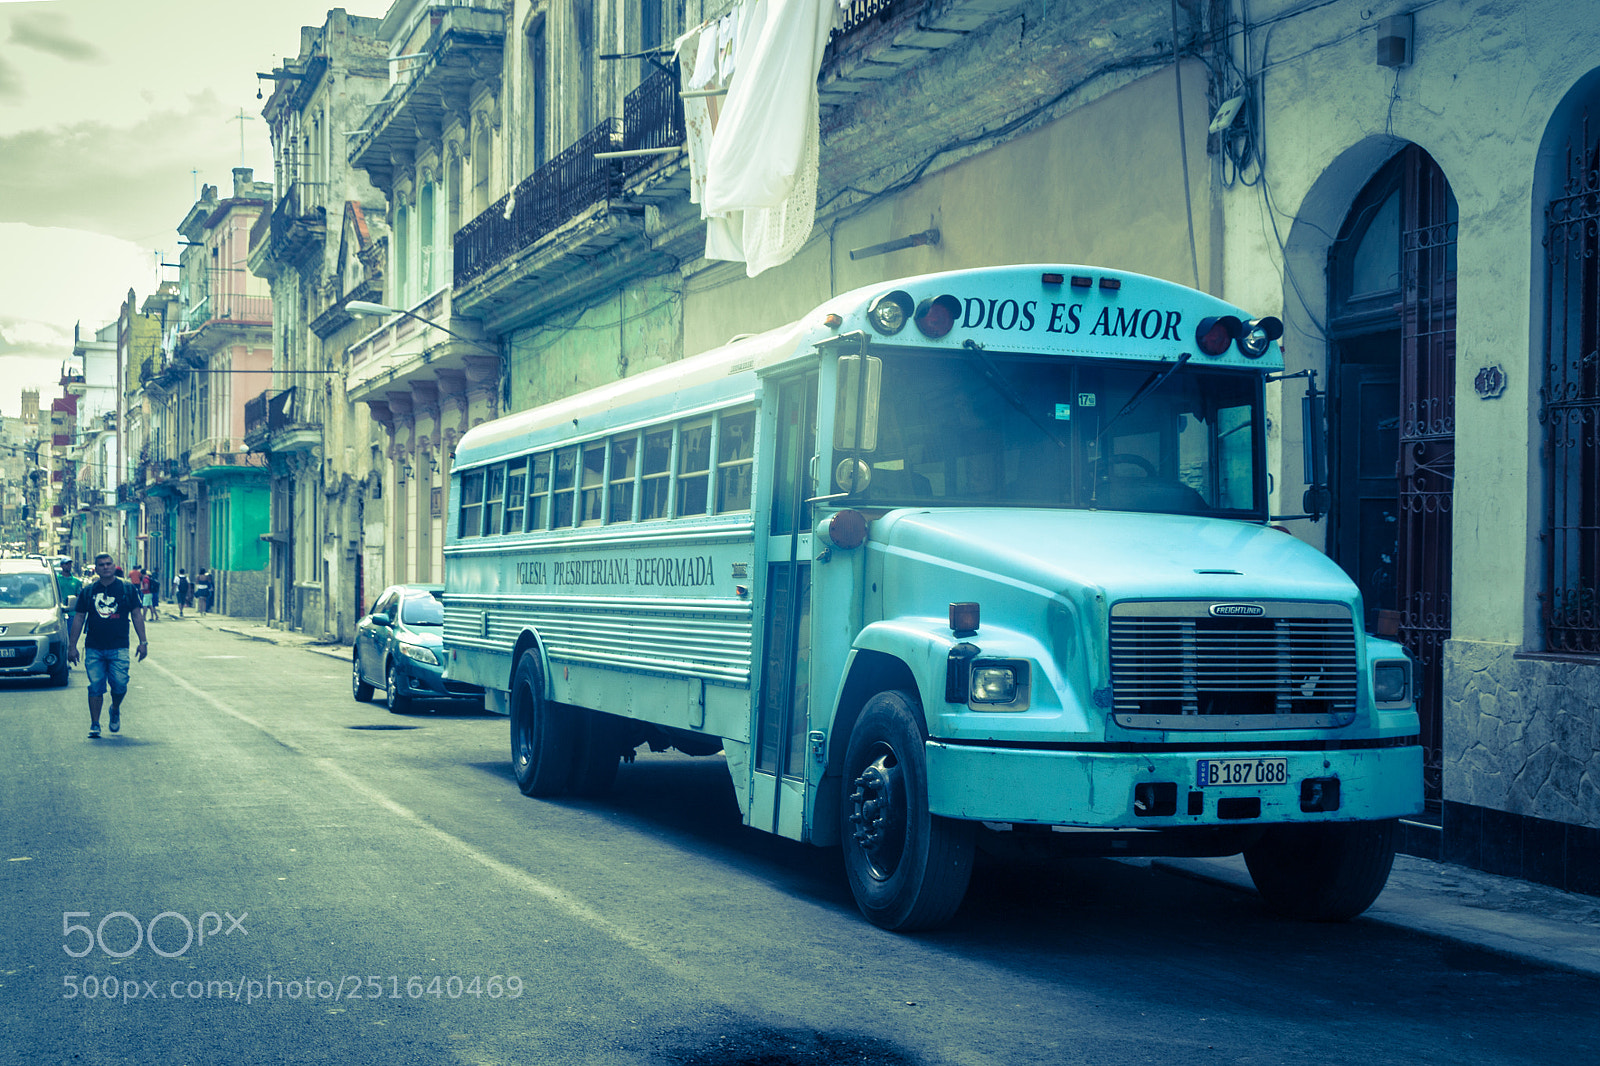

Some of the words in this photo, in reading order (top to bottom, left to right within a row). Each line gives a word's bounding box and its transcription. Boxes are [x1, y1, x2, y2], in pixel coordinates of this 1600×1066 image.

[961, 297, 1037, 331] DIOS
[1046, 302, 1083, 335] ES
[1089, 306, 1182, 341] AMOR
[516, 562, 547, 585] IGLESIA
[553, 557, 630, 586] PRESBITERIANA
[635, 556, 715, 587] REFORMADA
[1215, 605, 1261, 615] FREIGHTLINER
